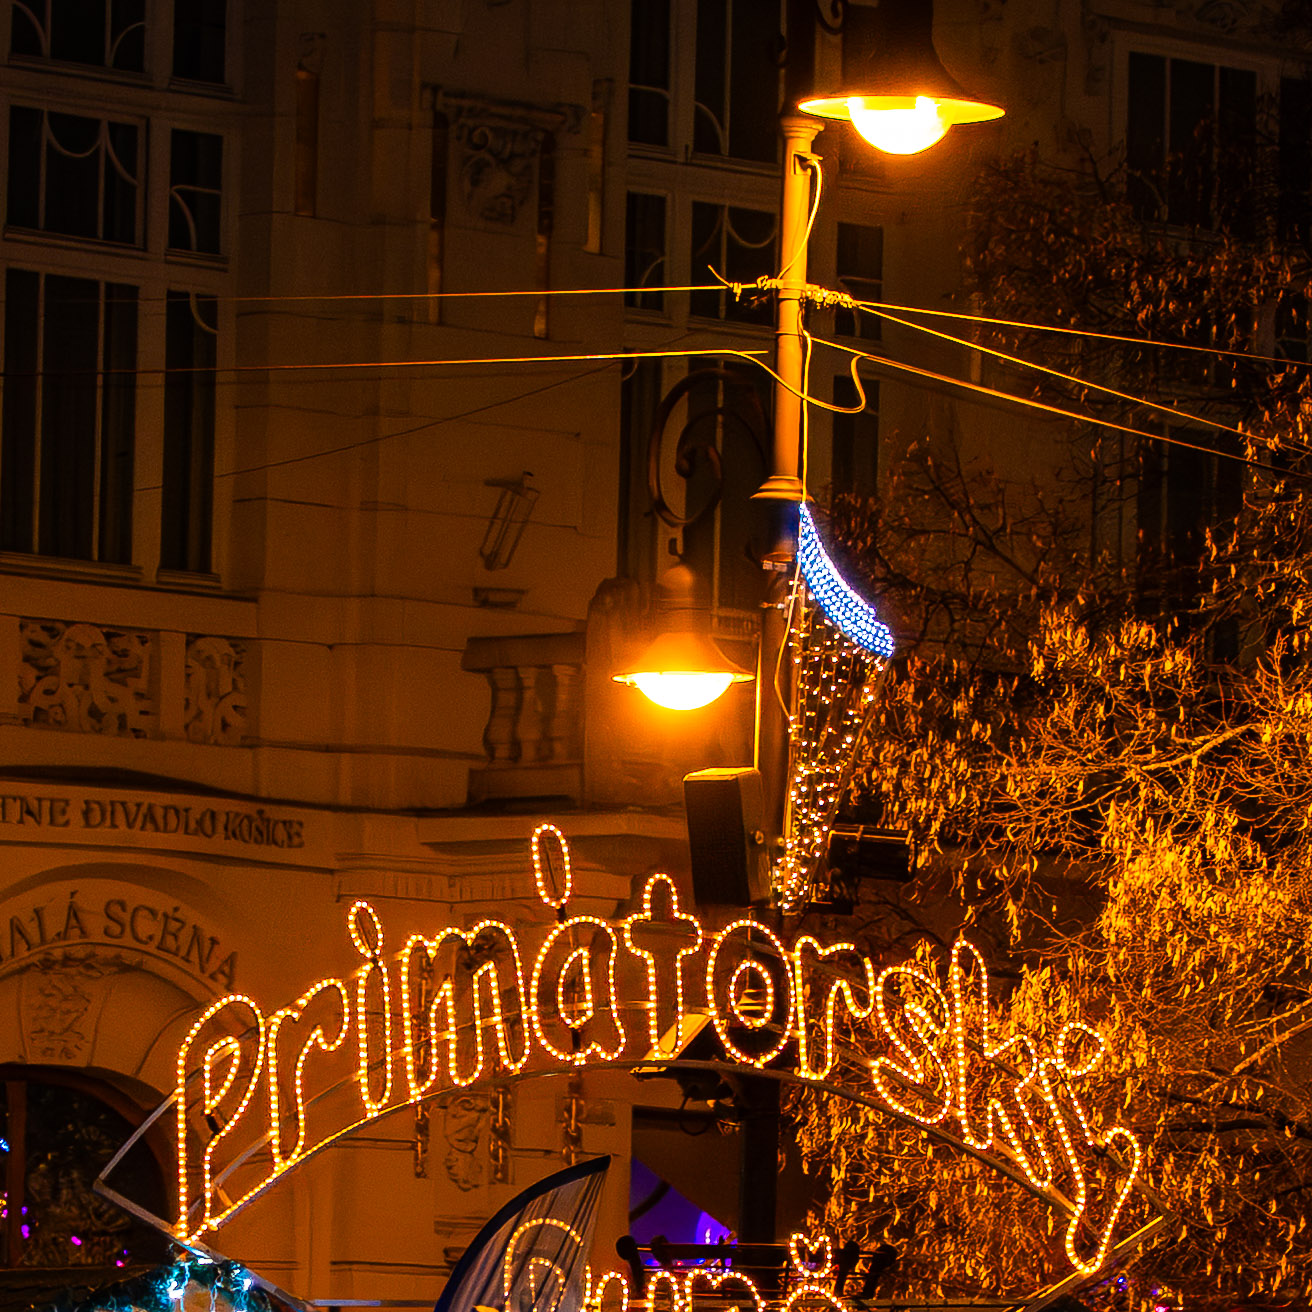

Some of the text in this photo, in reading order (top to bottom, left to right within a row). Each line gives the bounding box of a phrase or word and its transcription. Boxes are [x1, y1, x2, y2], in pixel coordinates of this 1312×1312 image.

[81, 799, 216, 839] DIVADLO
[223, 808, 305, 849] KOŠICE
[103, 899, 239, 991] SCÉNA
